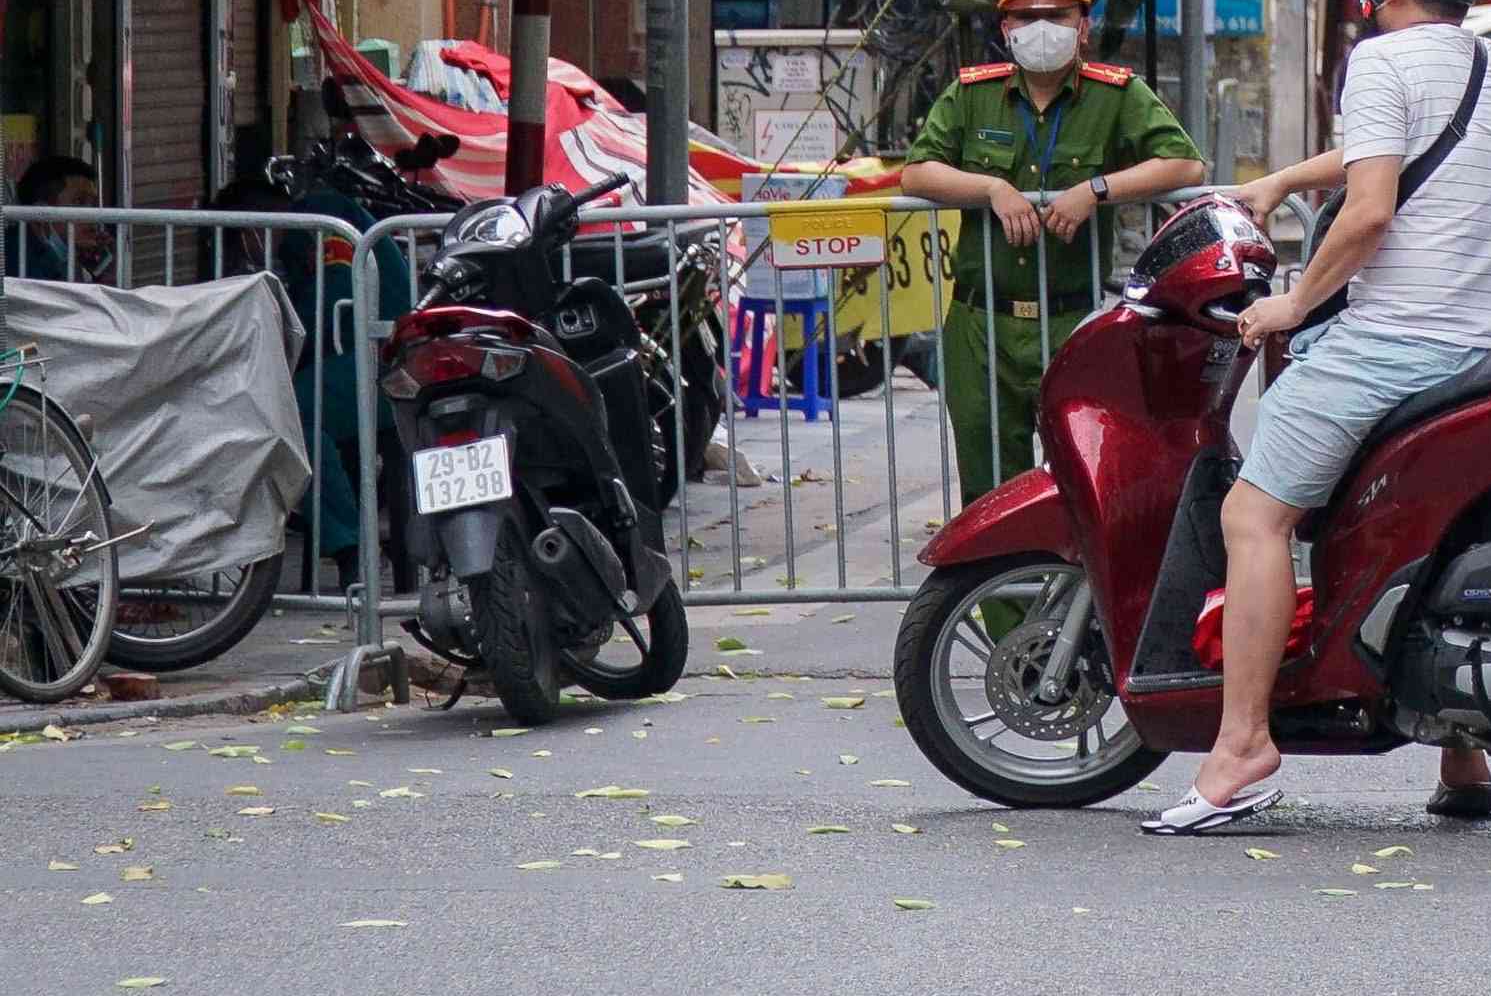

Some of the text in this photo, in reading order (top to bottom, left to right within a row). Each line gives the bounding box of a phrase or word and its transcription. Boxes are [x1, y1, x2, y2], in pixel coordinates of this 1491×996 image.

[796, 236, 861, 255] STOP
[428, 444, 494, 480] 29-B2
[425, 470, 504, 508] 132.98
